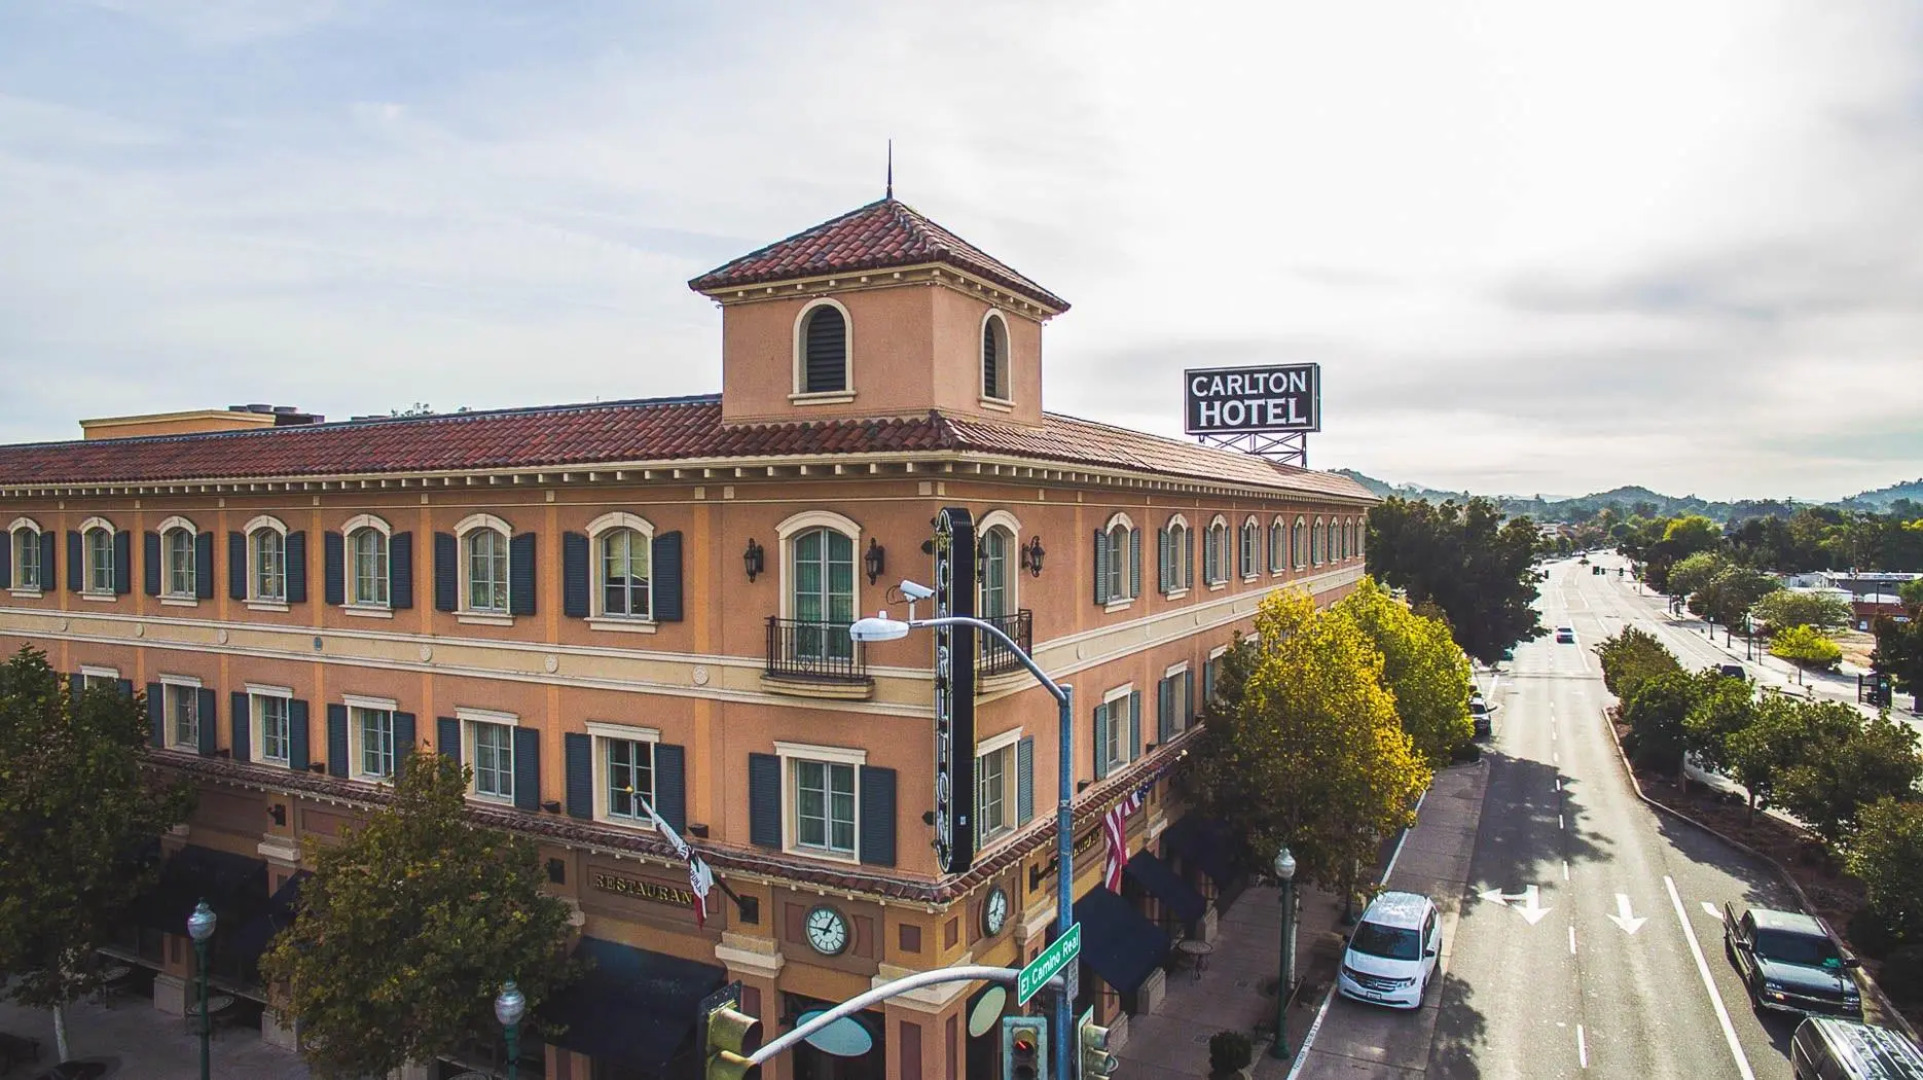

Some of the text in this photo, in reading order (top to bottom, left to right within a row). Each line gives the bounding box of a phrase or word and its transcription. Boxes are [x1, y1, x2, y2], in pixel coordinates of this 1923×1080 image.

[1192, 371, 1307, 397] CARLTON
[1199, 397, 1307, 427] HOTEL
[594, 873, 693, 905] RESTAURAN
[1021, 976, 1029, 996] El
[1032, 951, 1061, 985] Camino
[1062, 931, 1079, 957] Real
